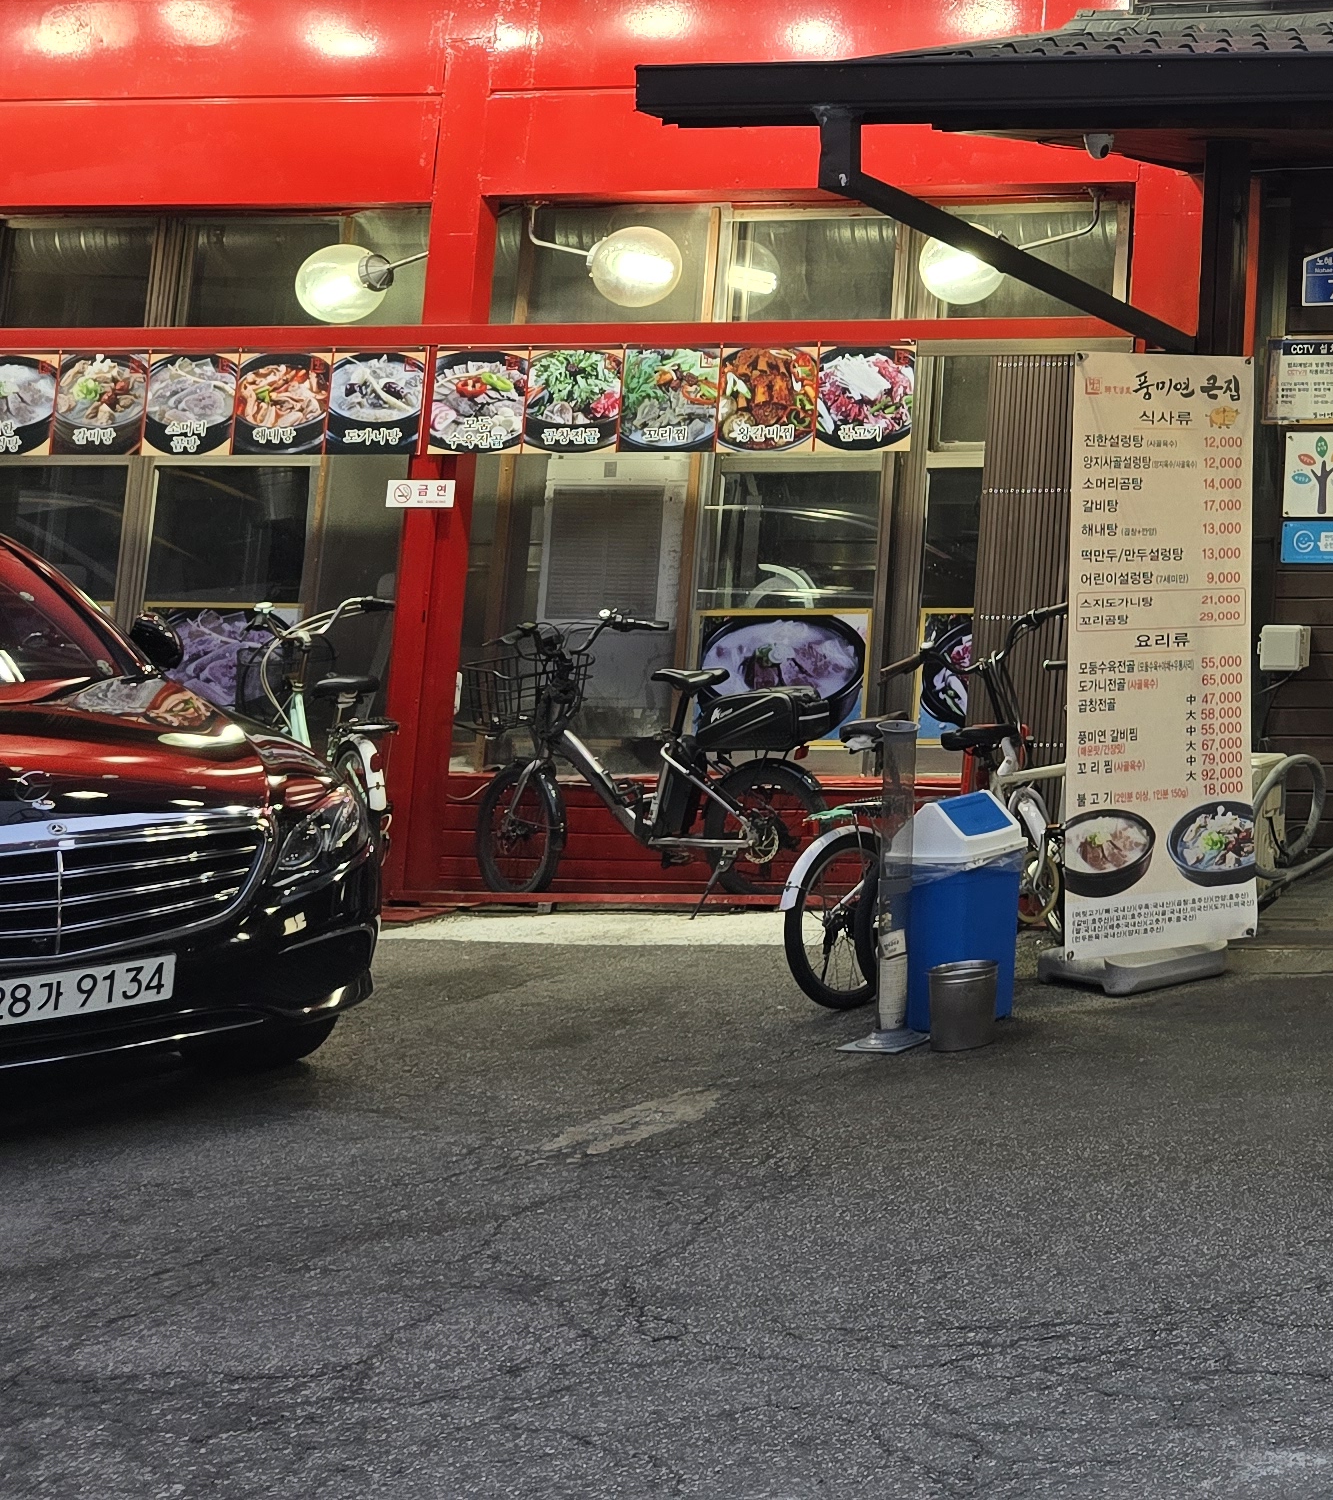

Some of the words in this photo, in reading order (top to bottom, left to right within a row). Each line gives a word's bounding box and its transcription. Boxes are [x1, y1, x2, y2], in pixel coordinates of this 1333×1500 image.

[1291, 344, 1315, 354] CCTV
[1132, 371, 1195, 401] 풍미연
[1200, 375, 1241, 402] 큰집
[1138, 411, 1193, 426] 식사류
[165, 420, 207, 437] 소머리
[643, 426, 688, 445] 꼬리찜
[735, 422, 795, 442] 왕갈비찜
[838, 423, 884, 442] 불고기
[343, 428, 402, 446] 도가니탕
[1083, 434, 1144, 448] 진한설렁탕
[1203, 436, 1242, 449] 12,000
[1083, 456, 1151, 471] 양지사골설렁탕
[1203, 457, 1242, 470] 12,000
[1082, 477, 1143, 491] 소머리곰탕
[1203, 478, 1242, 491] 14,000
[1082, 499, 1119, 513] 갈비탕
[1203, 499, 1242, 513] 17,000
[1081, 523, 1118, 537] 해내탕
[1202, 521, 1242, 535] 13,000
[1081, 548, 1184, 563] 떡만두/만두설렁탕
[1201, 547, 1241, 560] 13,000
[1080, 572, 1154, 586] 어린이설렁탕
[1206, 571, 1241, 584] 9,000
[1079, 596, 1153, 609] 스지도가니탕
[1201, 594, 1241, 606] 21,000
[1079, 614, 1129, 626] 꼬리곰탕
[1199, 611, 1241, 623] 29,000
[1134, 632, 1191, 649] 요리류
[1201, 655, 1243, 670] 55,000
[1078, 678, 1126, 693] 도가니전골
[1201, 672, 1243, 687] 65,000
[1078, 698, 1117, 713] 곱창전골
[1186, 694, 1197, 706] 中
[1201, 691, 1242, 706] 47,000
[1185, 709, 1197, 721] 大
[1200, 706, 1242, 721] 58,000
[1077, 729, 1107, 745] 풍미연
[1110, 727, 1138, 743] 갈비찜
[1186, 725, 1197, 737] 中
[1201, 721, 1243, 735] 55,000
[1185, 740, 1197, 752] 大
[1201, 737, 1243, 751] 67,000
[1186, 755, 1197, 767] 中
[1201, 752, 1243, 766] 79,000
[1185, 770, 1197, 782] 大
[1201, 766, 1243, 781] 92,000
[1203, 781, 1243, 796] 18,000
[76, 962, 166, 1008] 9134
